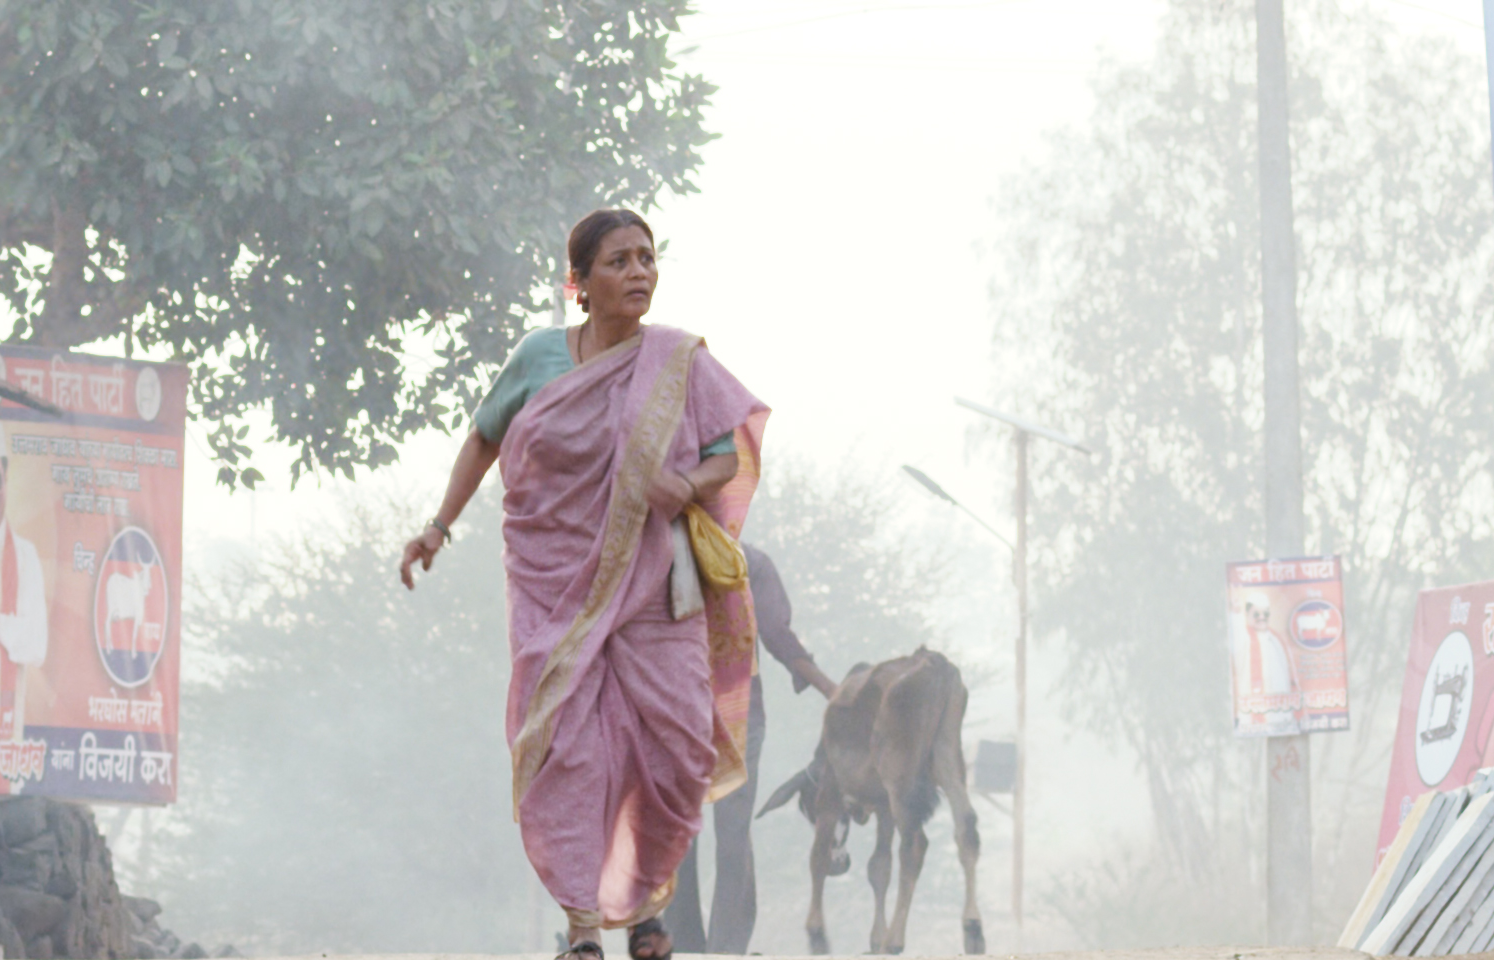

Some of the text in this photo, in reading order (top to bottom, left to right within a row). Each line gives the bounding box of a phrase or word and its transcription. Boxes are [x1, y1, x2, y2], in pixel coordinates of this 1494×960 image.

[49, 354, 83, 409] हित
[88, 687, 129, 724] भरघोस
[78, 731, 137, 784] विजयी
[140, 750, 173, 785] करा
